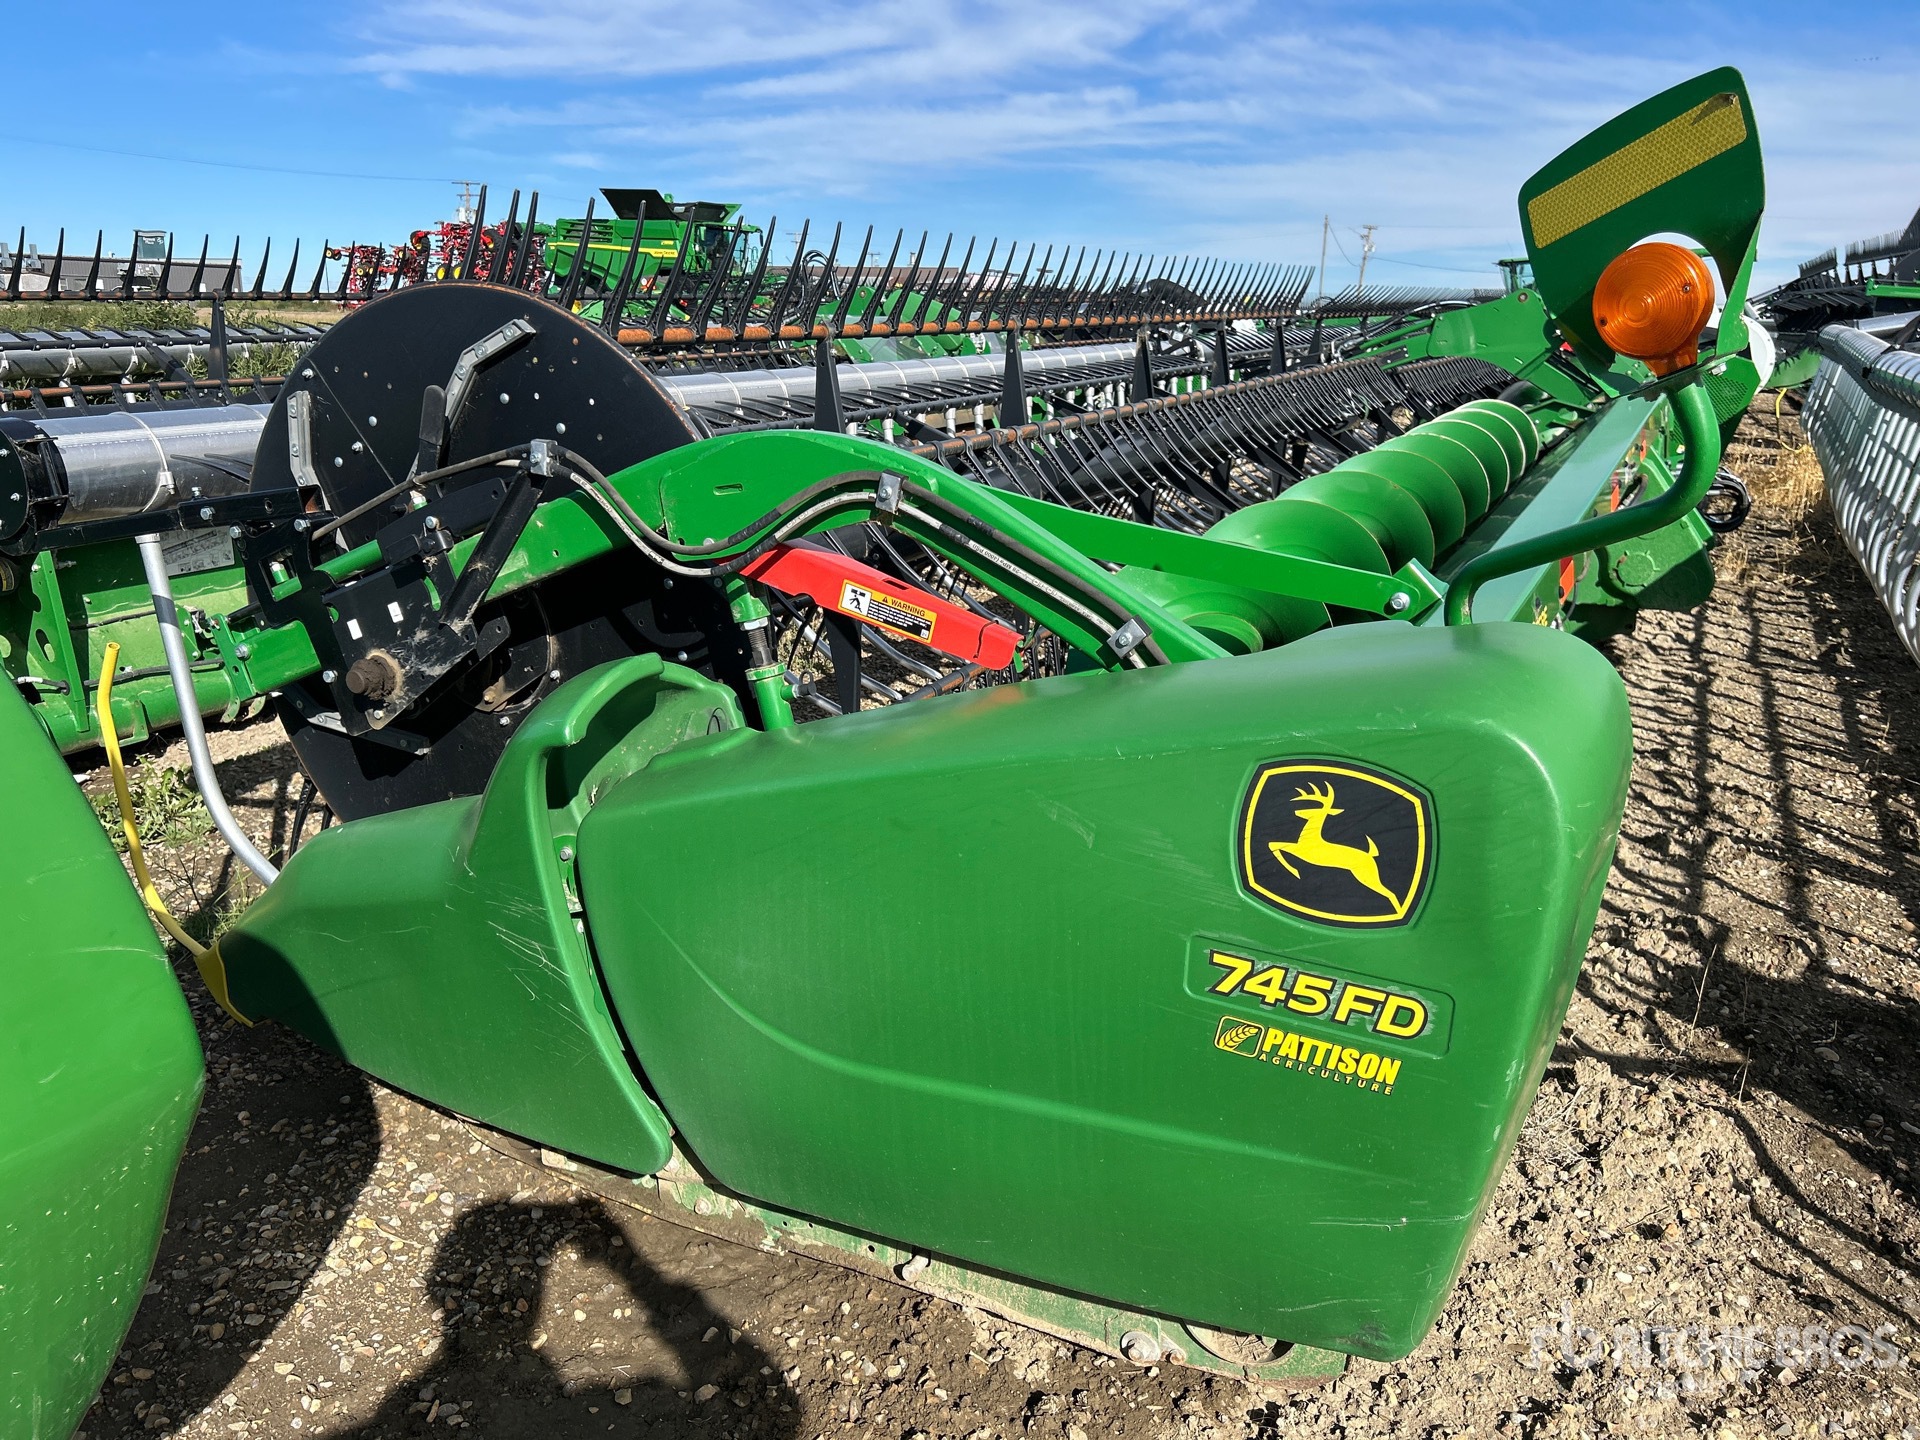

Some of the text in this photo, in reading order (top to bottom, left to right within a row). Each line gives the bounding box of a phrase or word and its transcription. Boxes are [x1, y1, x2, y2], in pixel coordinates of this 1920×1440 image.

[891, 598, 926, 617] WARNING
[1209, 949, 1428, 1040] 745FD
[1258, 1053, 1395, 1095] AGRICULTURE
[1262, 1027, 1402, 1086] PATTISON
